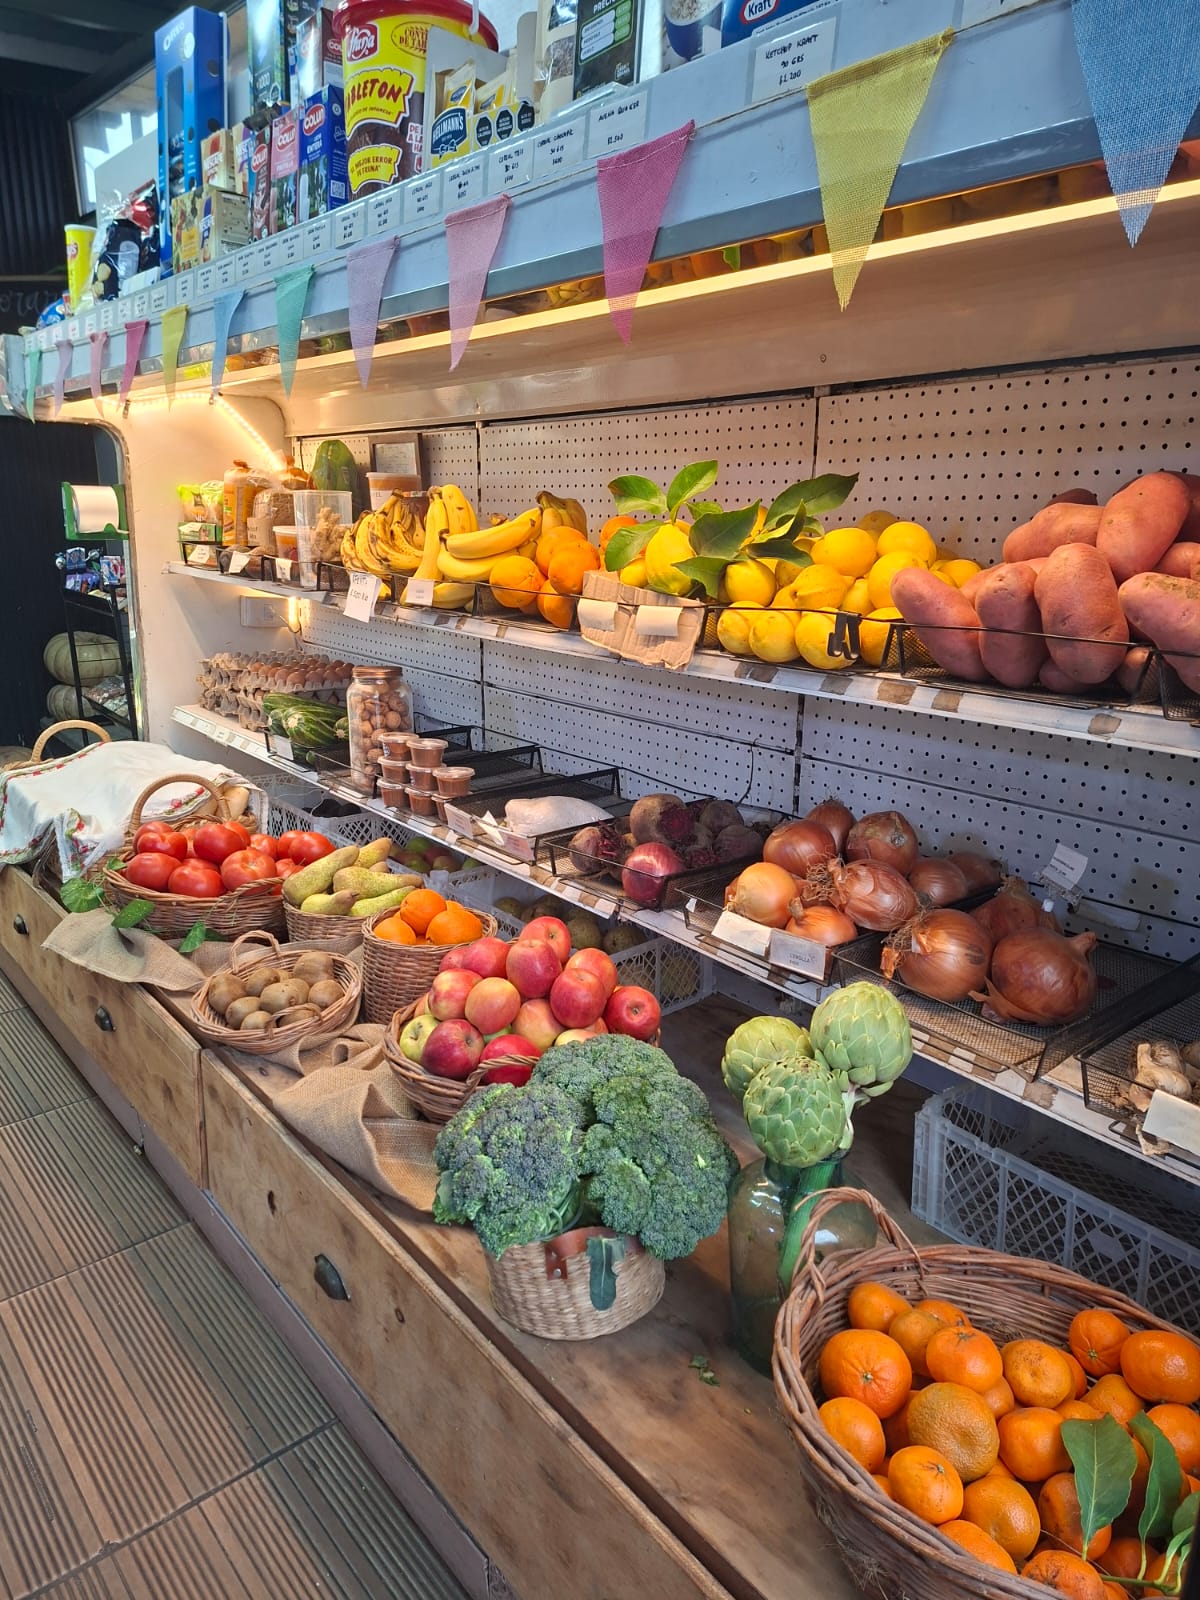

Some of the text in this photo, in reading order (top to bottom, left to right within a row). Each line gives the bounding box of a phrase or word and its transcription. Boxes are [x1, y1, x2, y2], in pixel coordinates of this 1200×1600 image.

[748, 0, 772, 17] Kraft
[346, 78, 402, 112] ABLETON
[304, 108, 324, 130] COLUN
